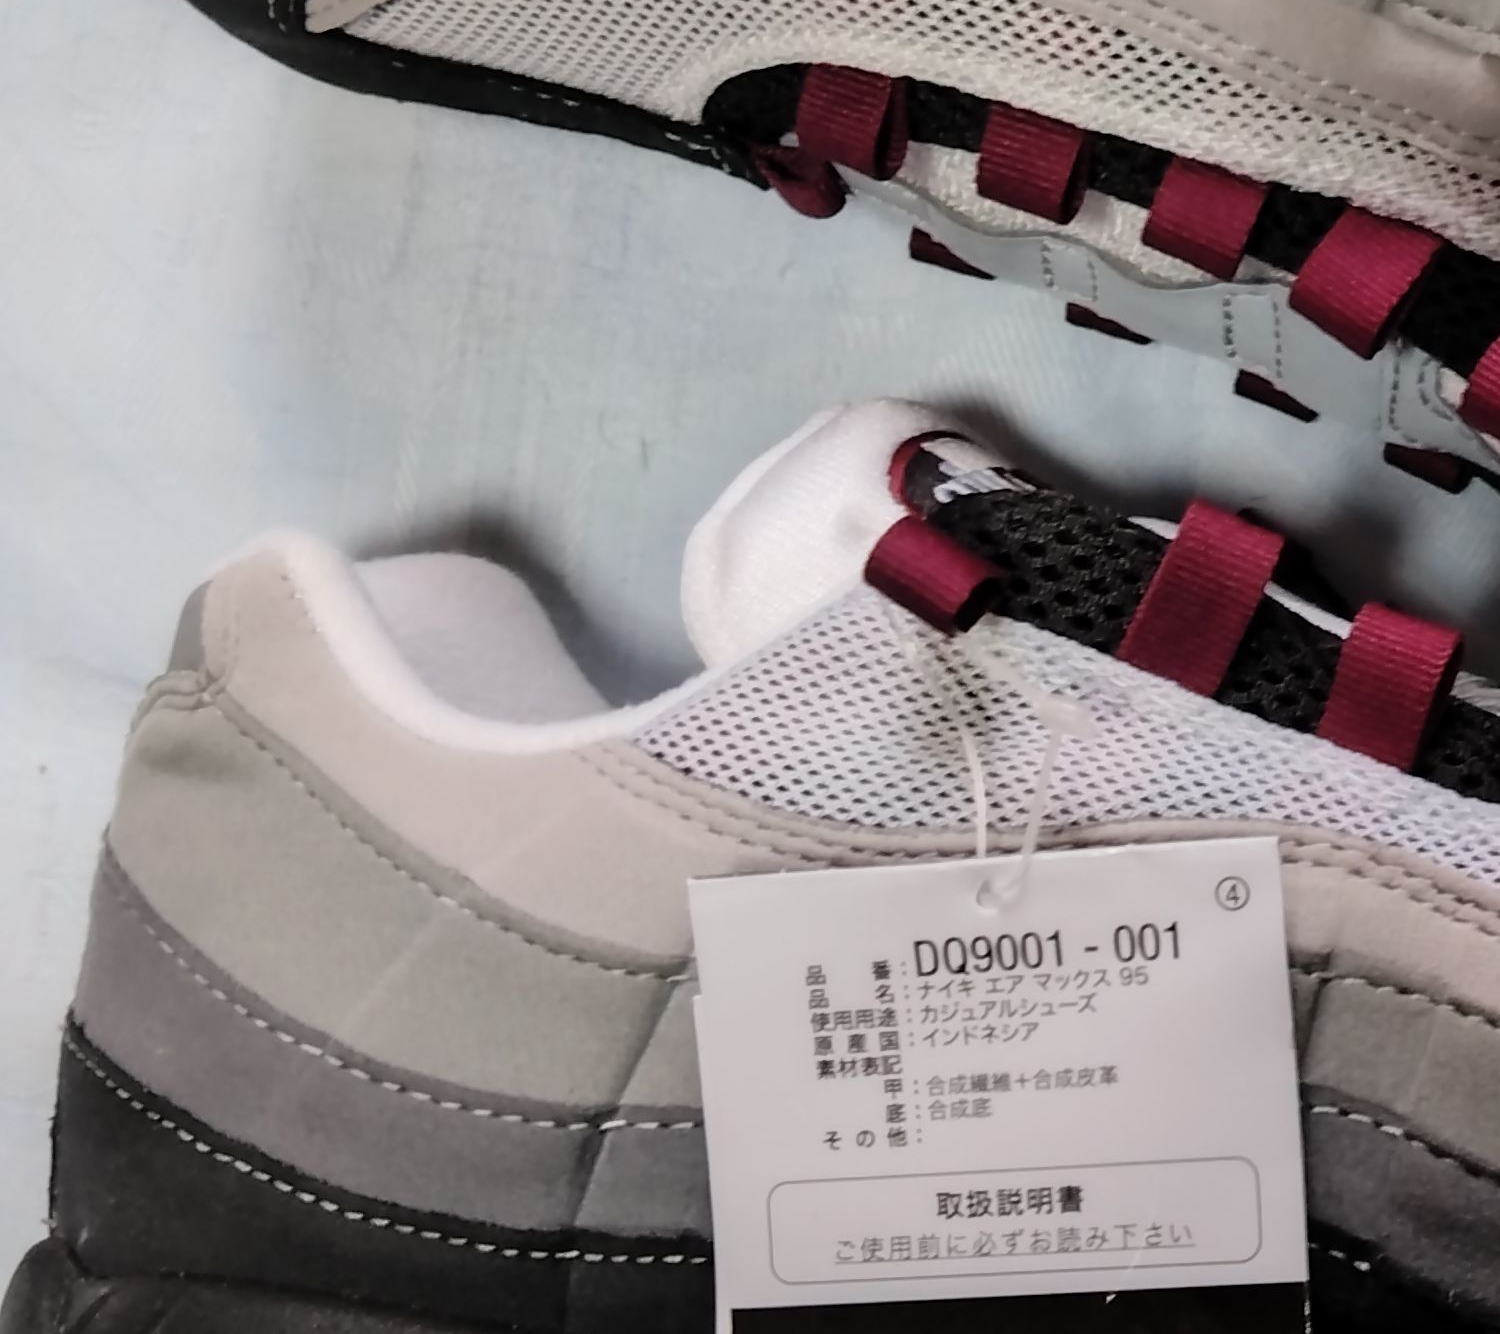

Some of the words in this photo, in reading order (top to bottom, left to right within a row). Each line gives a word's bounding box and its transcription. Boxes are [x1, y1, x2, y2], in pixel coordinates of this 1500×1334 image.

[913, 930, 1063, 977] DQ9001
[1113, 921, 1180, 963] 001
[1119, 966, 1149, 986] 95
[920, 992, 1097, 1024] カジュアルシューズ
[922, 1022, 1039, 1047] インドネシア
[816, 1055, 903, 1080] 素材表記
[936, 1185, 1083, 1219] 取扱説明書
[835, 1223, 1193, 1263] ご使用前に必ずお読み下さい
